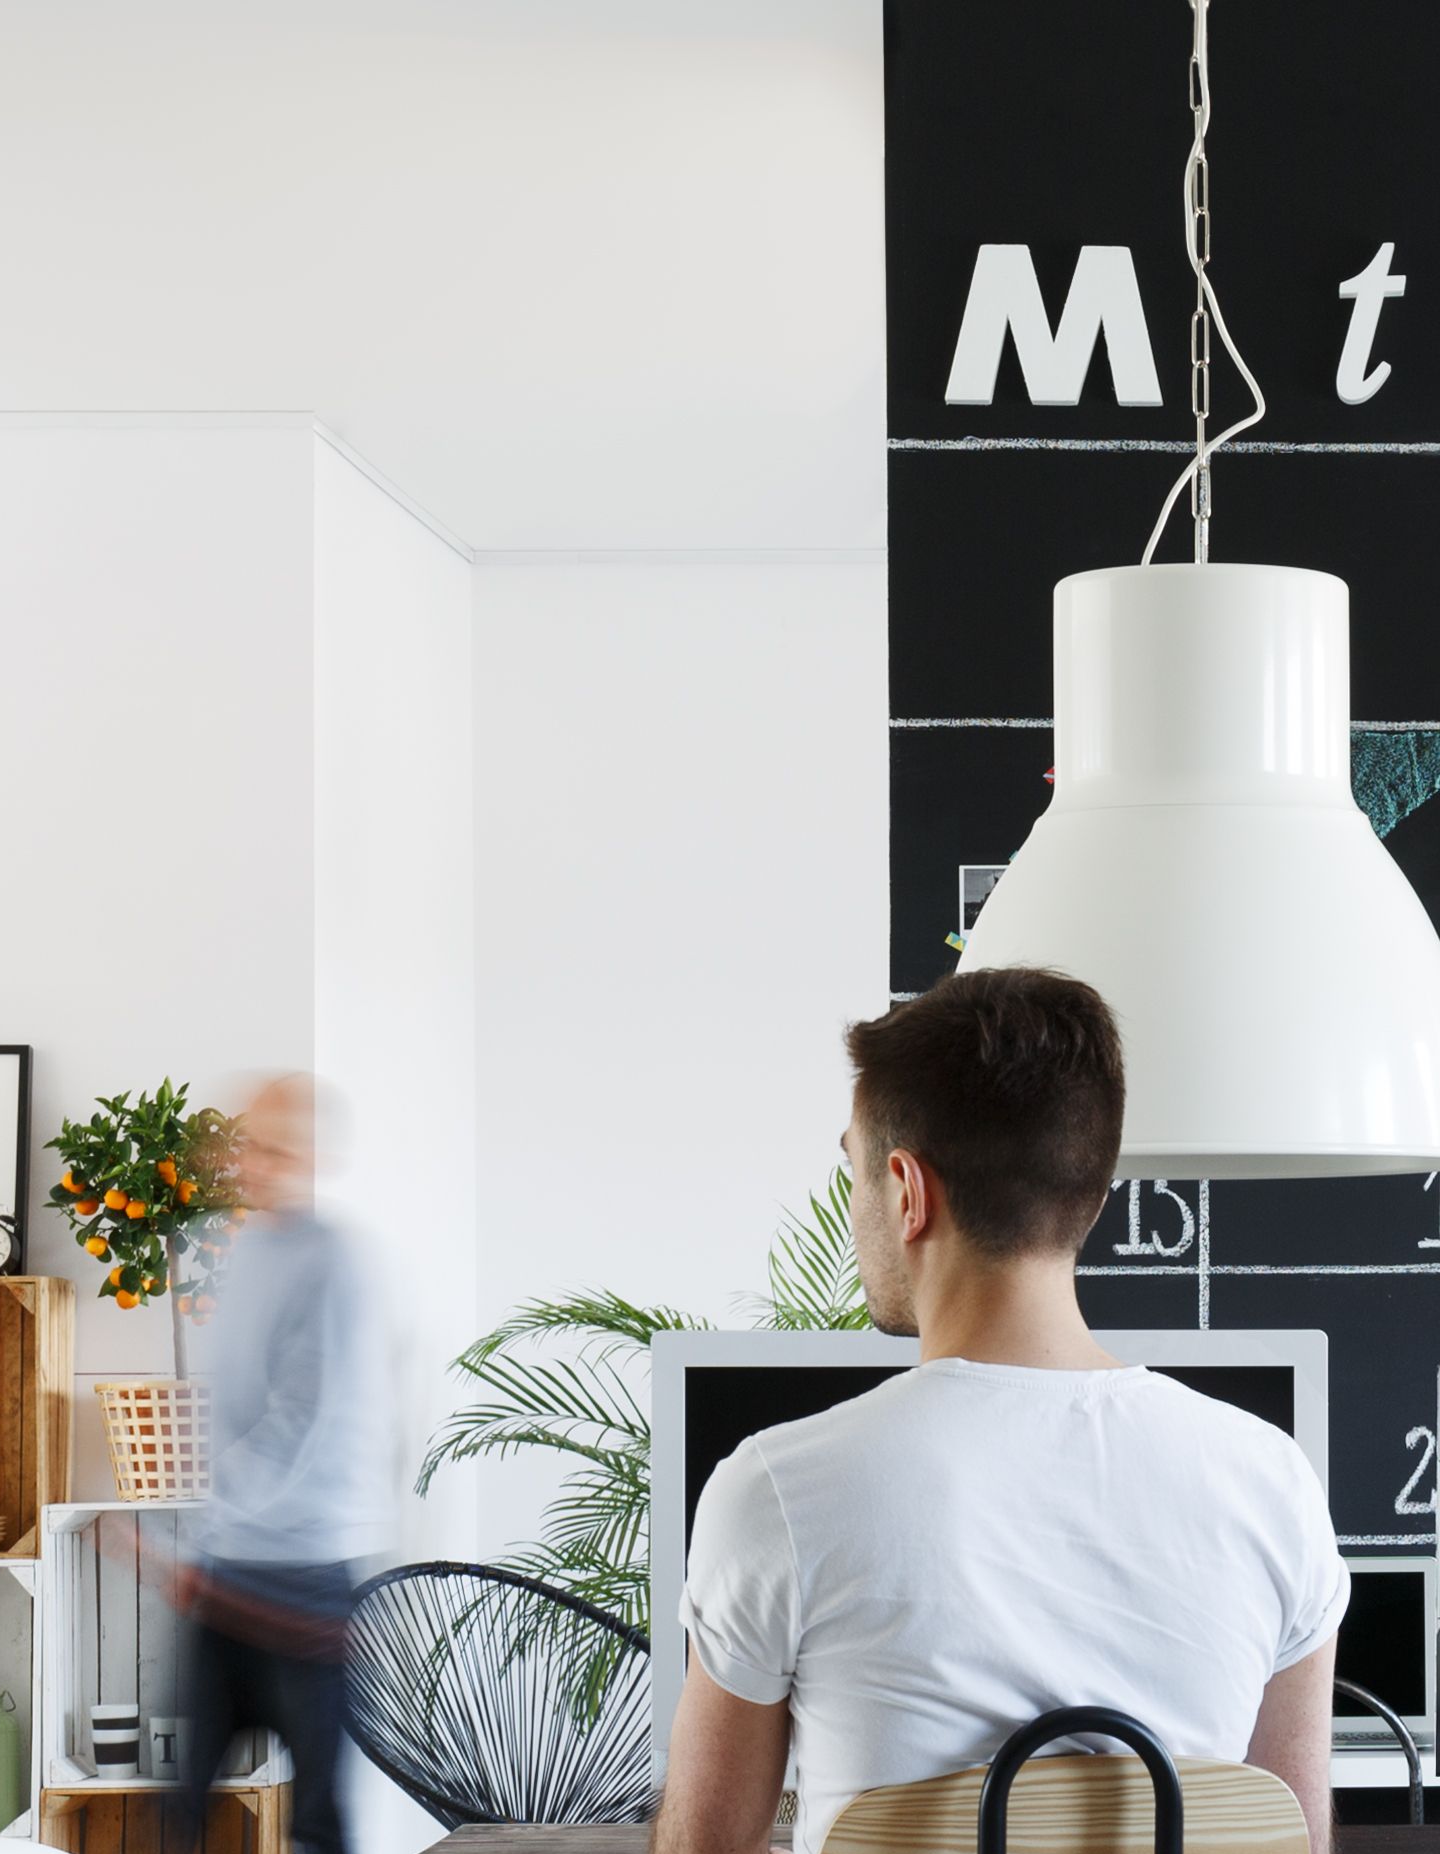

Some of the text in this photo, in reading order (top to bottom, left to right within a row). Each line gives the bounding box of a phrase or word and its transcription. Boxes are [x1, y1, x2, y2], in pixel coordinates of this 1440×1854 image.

[945, 244, 1163, 406] M
[1336, 242, 1406, 404] t
[1111, 1179, 1195, 1257] 15
[1394, 1426, 1436, 1514] 2
